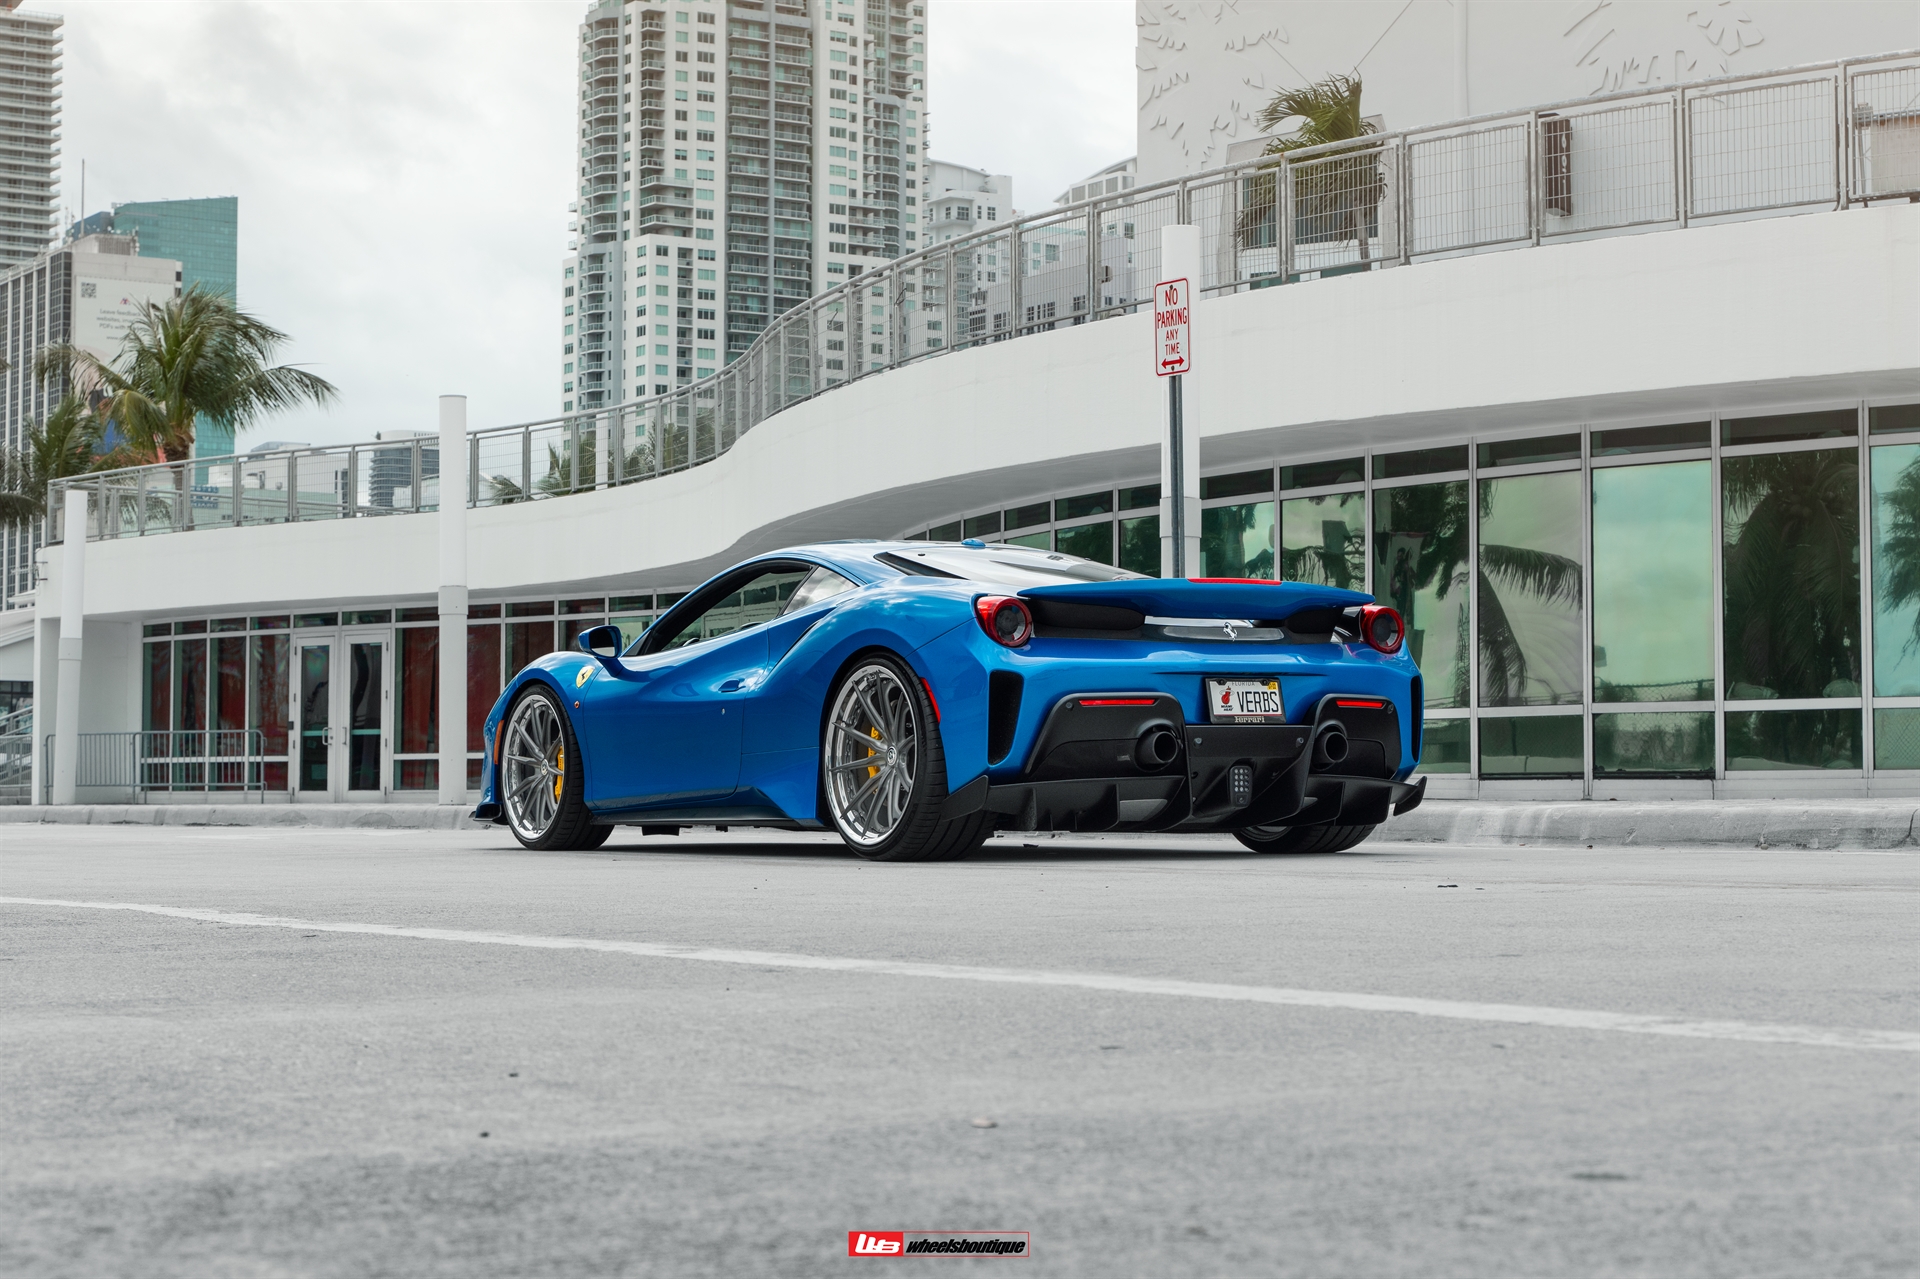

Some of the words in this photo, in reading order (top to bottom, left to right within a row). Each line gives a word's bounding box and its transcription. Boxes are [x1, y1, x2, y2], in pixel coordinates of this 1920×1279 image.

[1165, 288, 1178, 306] NO
[1157, 307, 1187, 329] PARKING
[1166, 329, 1178, 341] ANY
[1165, 342, 1180, 355] TIME
[1237, 691, 1279, 712] VERBS
